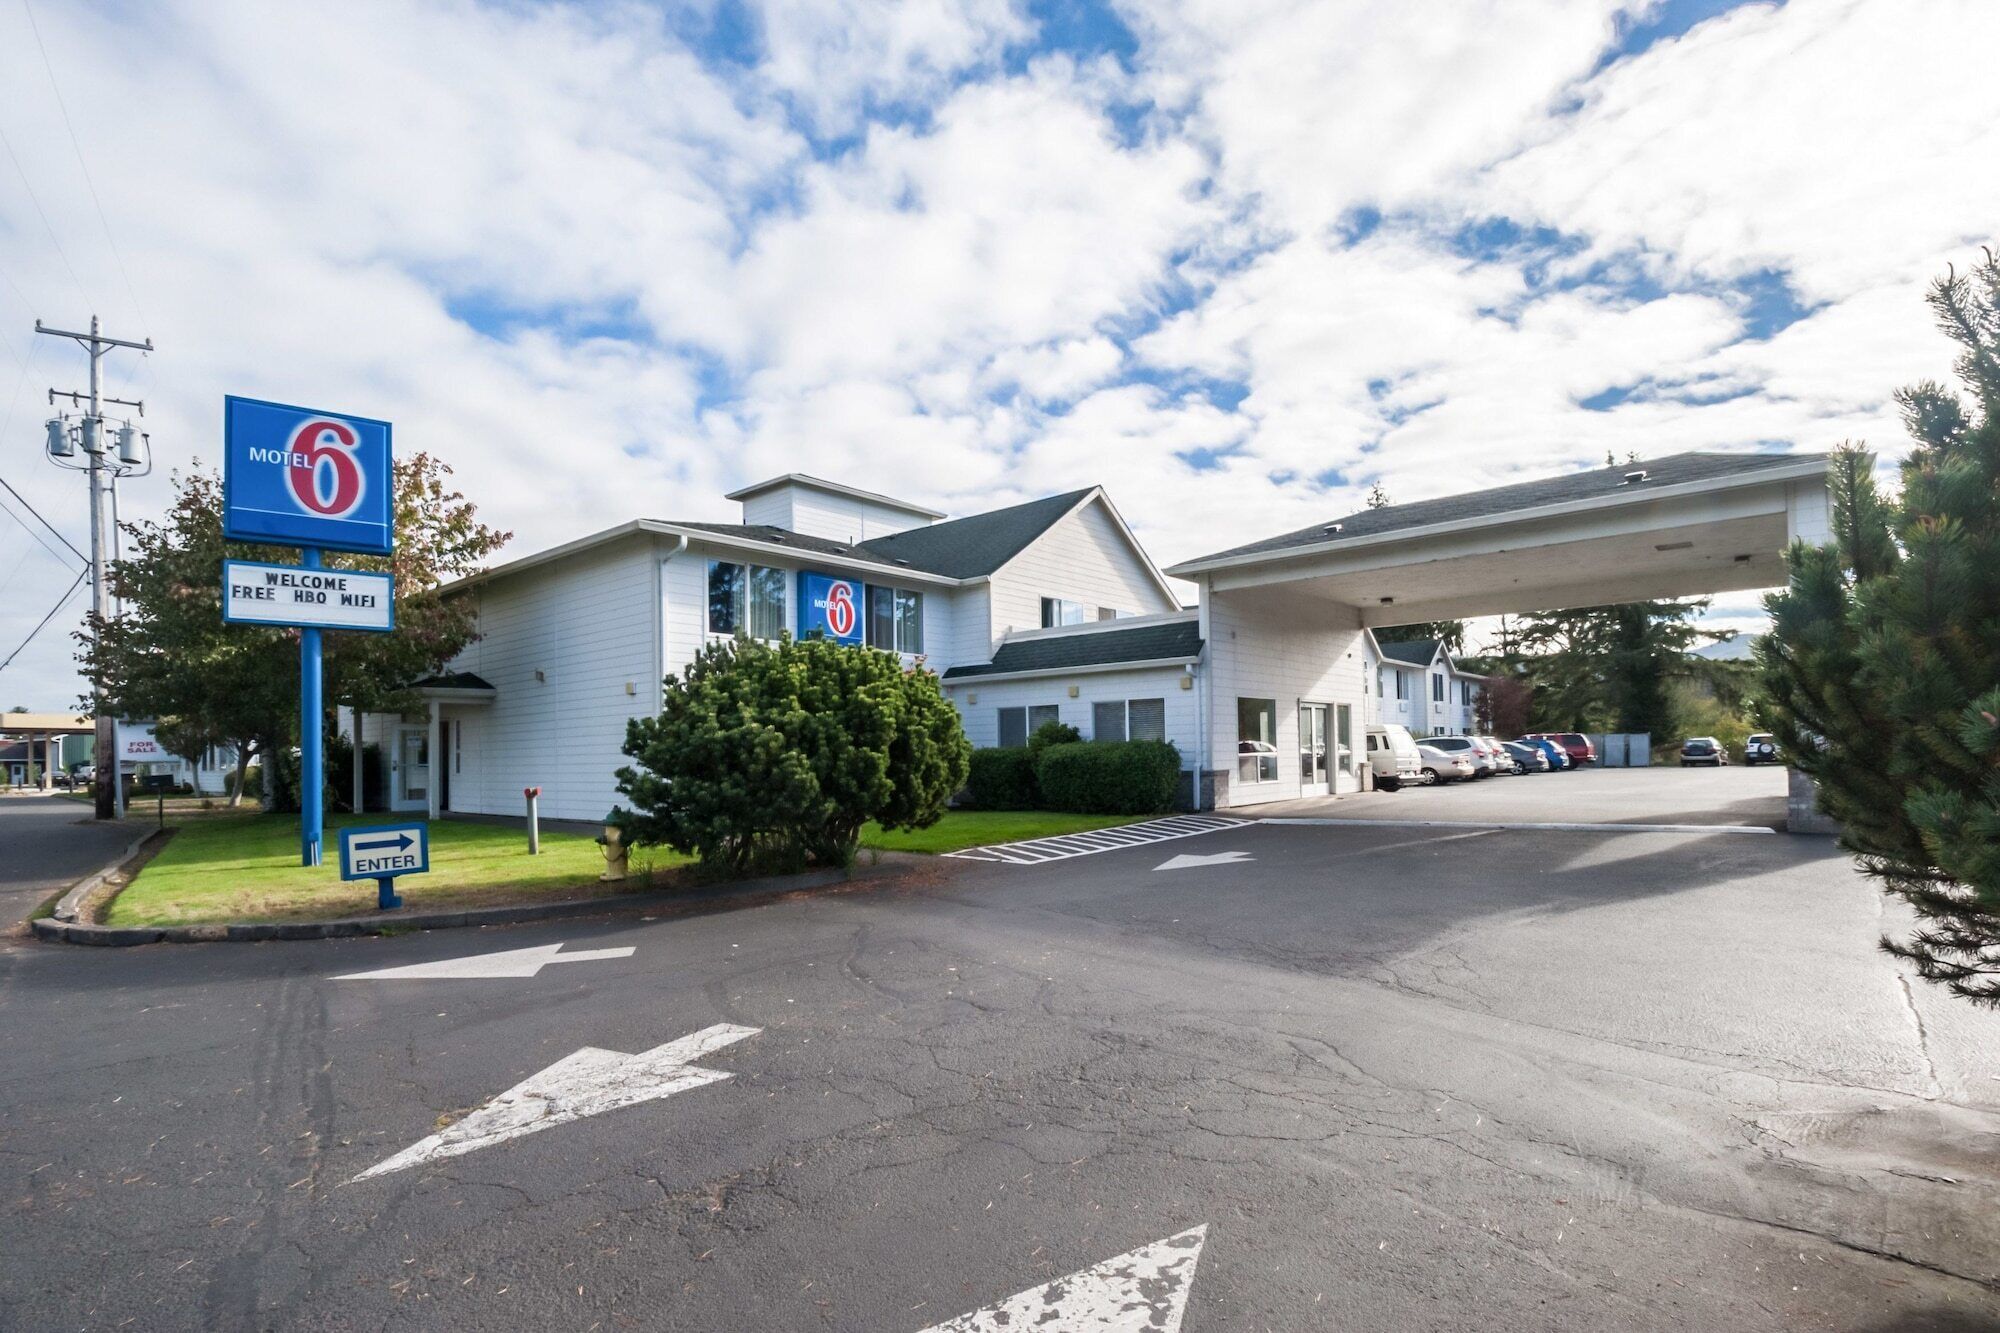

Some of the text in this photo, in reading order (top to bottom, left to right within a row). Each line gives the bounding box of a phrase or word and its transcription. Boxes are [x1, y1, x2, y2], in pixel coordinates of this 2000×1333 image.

[249, 417, 366, 518] MOTEL 6
[265, 572, 347, 591] WELCOME
[232, 585, 375, 608] FREE HBO WIFI
[814, 581, 855, 636] MOTEL 6
[356, 855, 415, 872] ENTER
